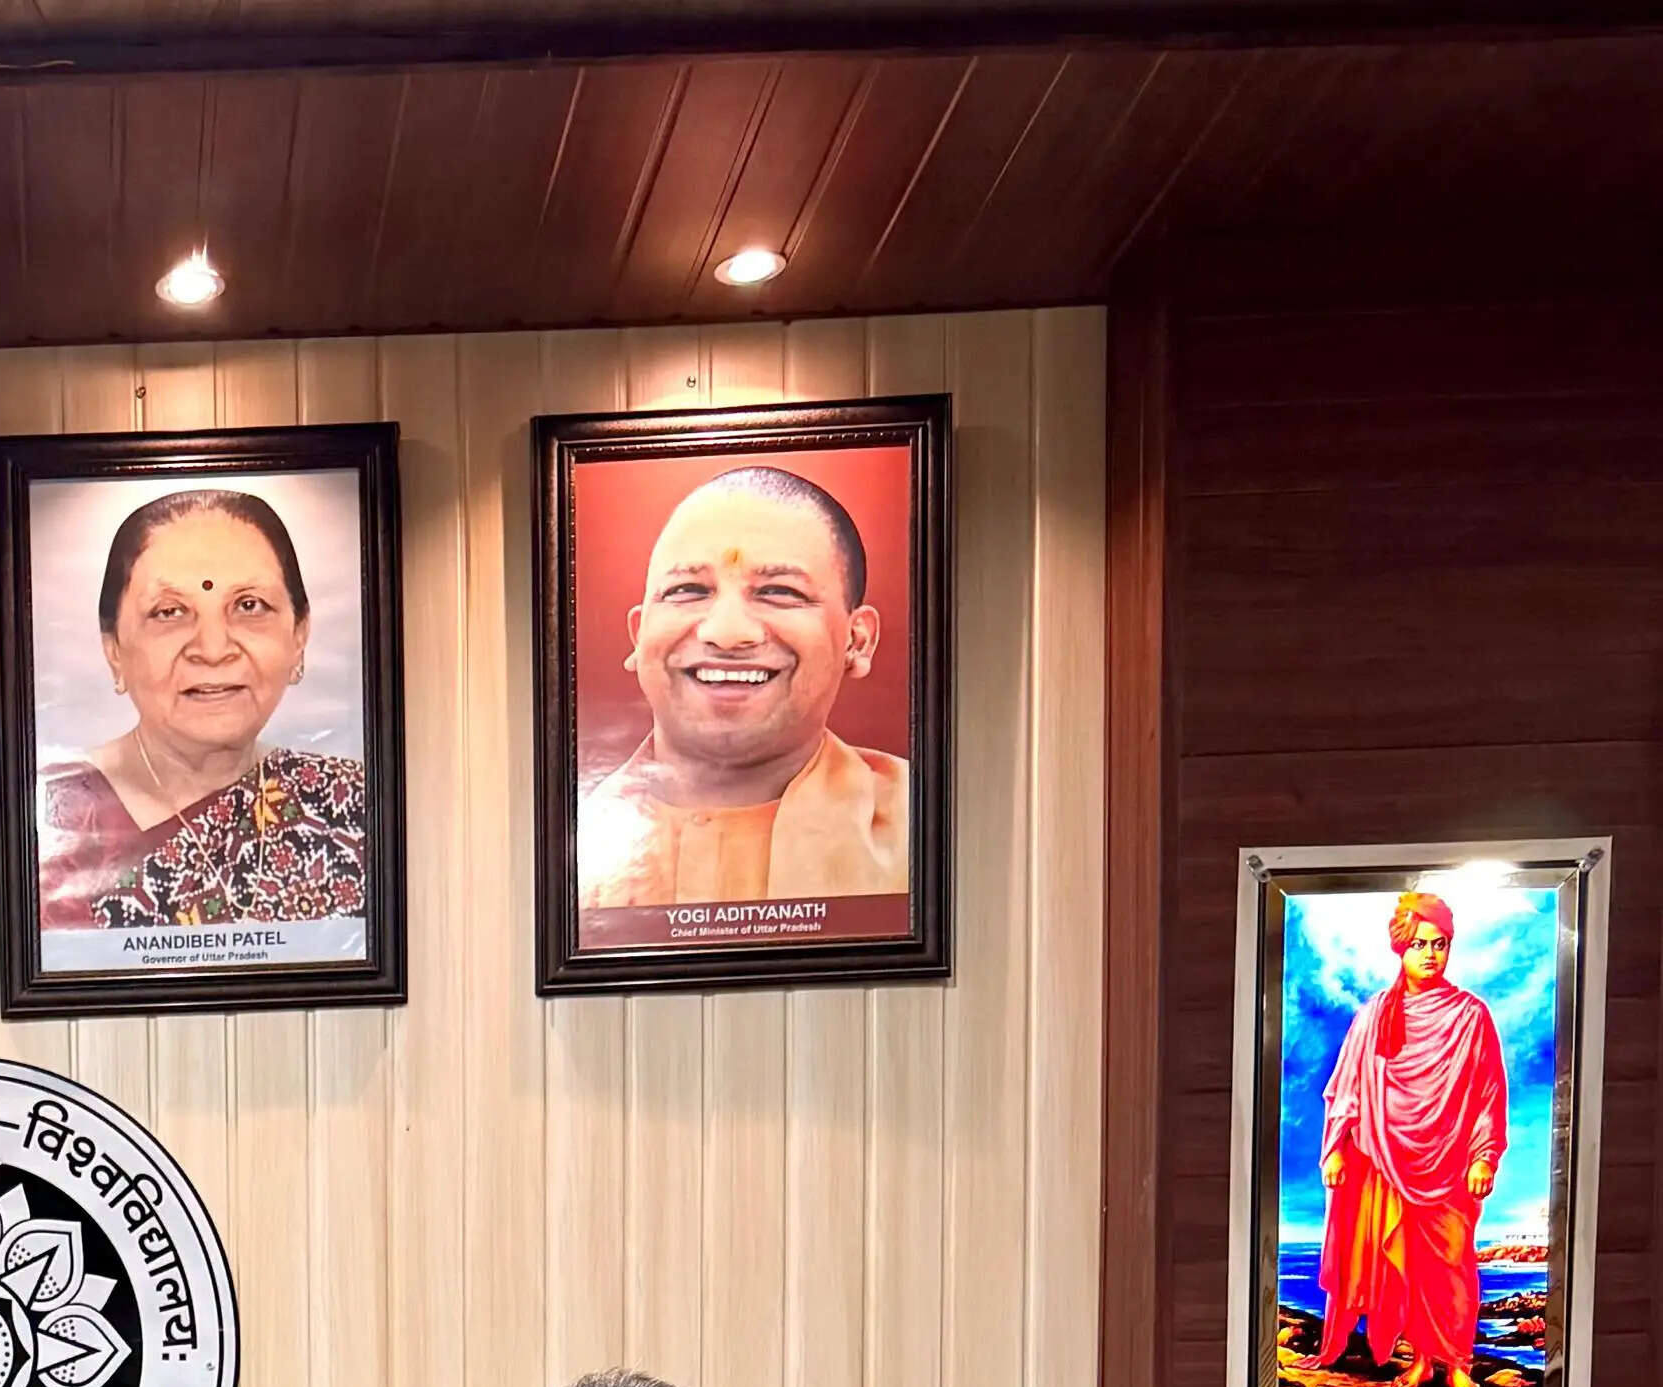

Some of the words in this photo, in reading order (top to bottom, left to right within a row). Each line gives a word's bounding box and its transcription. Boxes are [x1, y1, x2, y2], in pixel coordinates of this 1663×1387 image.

[666, 908, 710, 925] YOGI
[714, 903, 826, 922] ADITYANATH
[670, 927, 697, 937] Chief
[699, 925, 739, 937] Minister
[741, 925, 751, 935] of
[780, 922, 822, 933] Pradesh
[123, 934, 227, 951] ANANDIBEN
[232, 931, 286, 947] PATEL
[142, 955, 186, 965] Governor
[190, 953, 200, 963] of
[202, 953, 225, 962] Uttar
[228, 951, 268, 961] Pradesh
